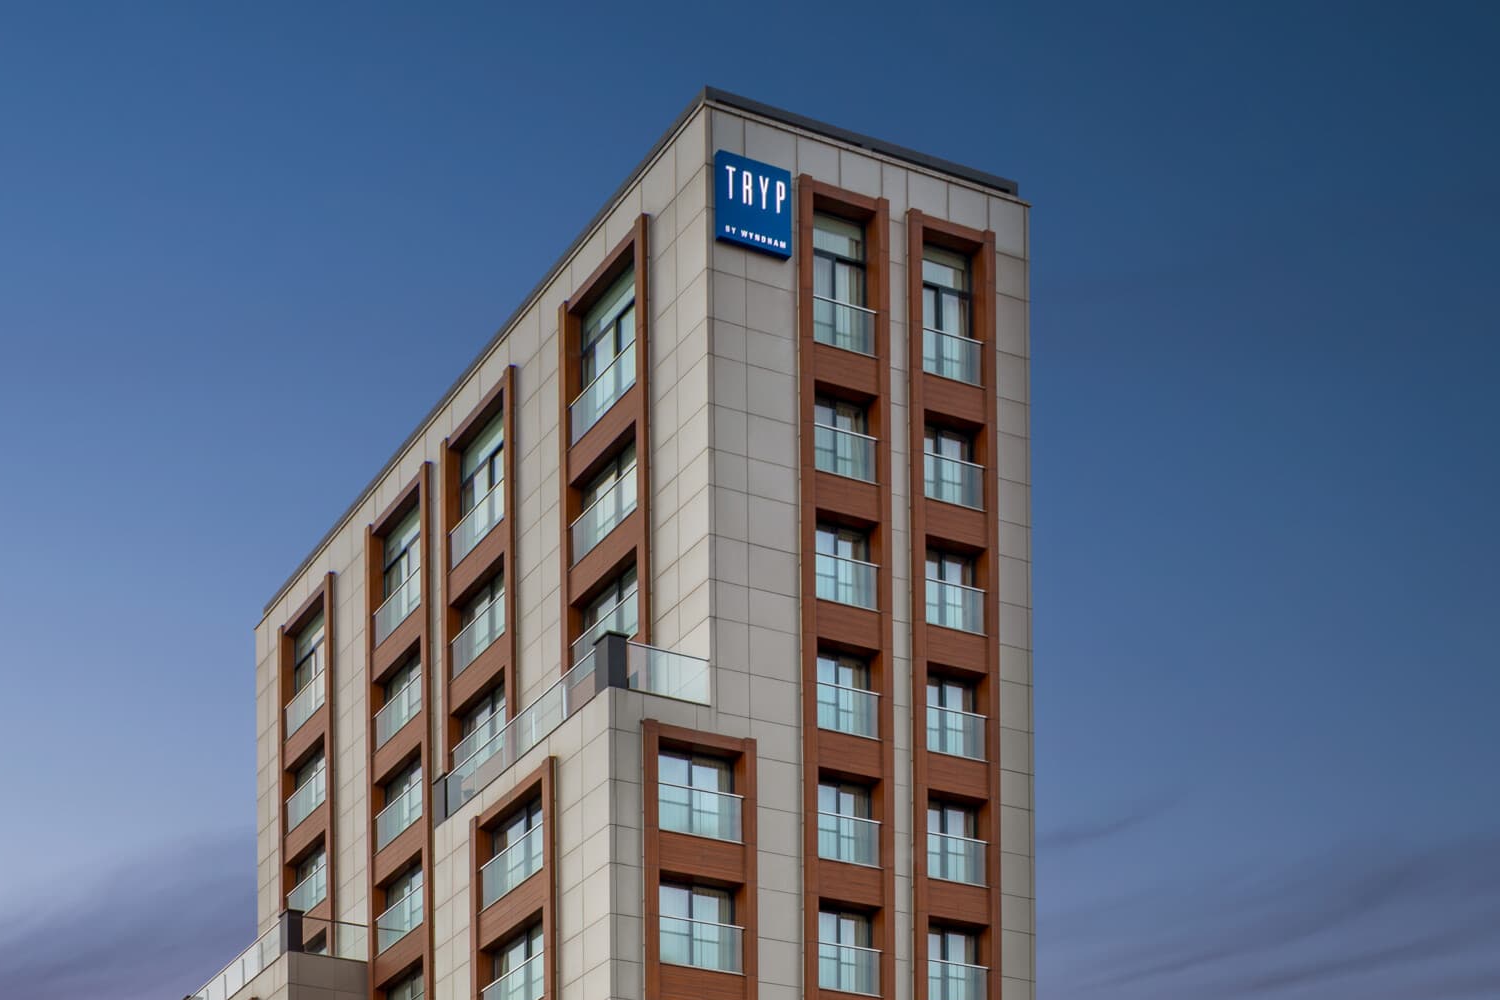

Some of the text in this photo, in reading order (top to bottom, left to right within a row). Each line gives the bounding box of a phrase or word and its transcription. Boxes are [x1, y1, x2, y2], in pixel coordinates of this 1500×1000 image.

[725, 165, 786, 214] TRYP
[725, 225, 786, 249] BY WYNDHAM
